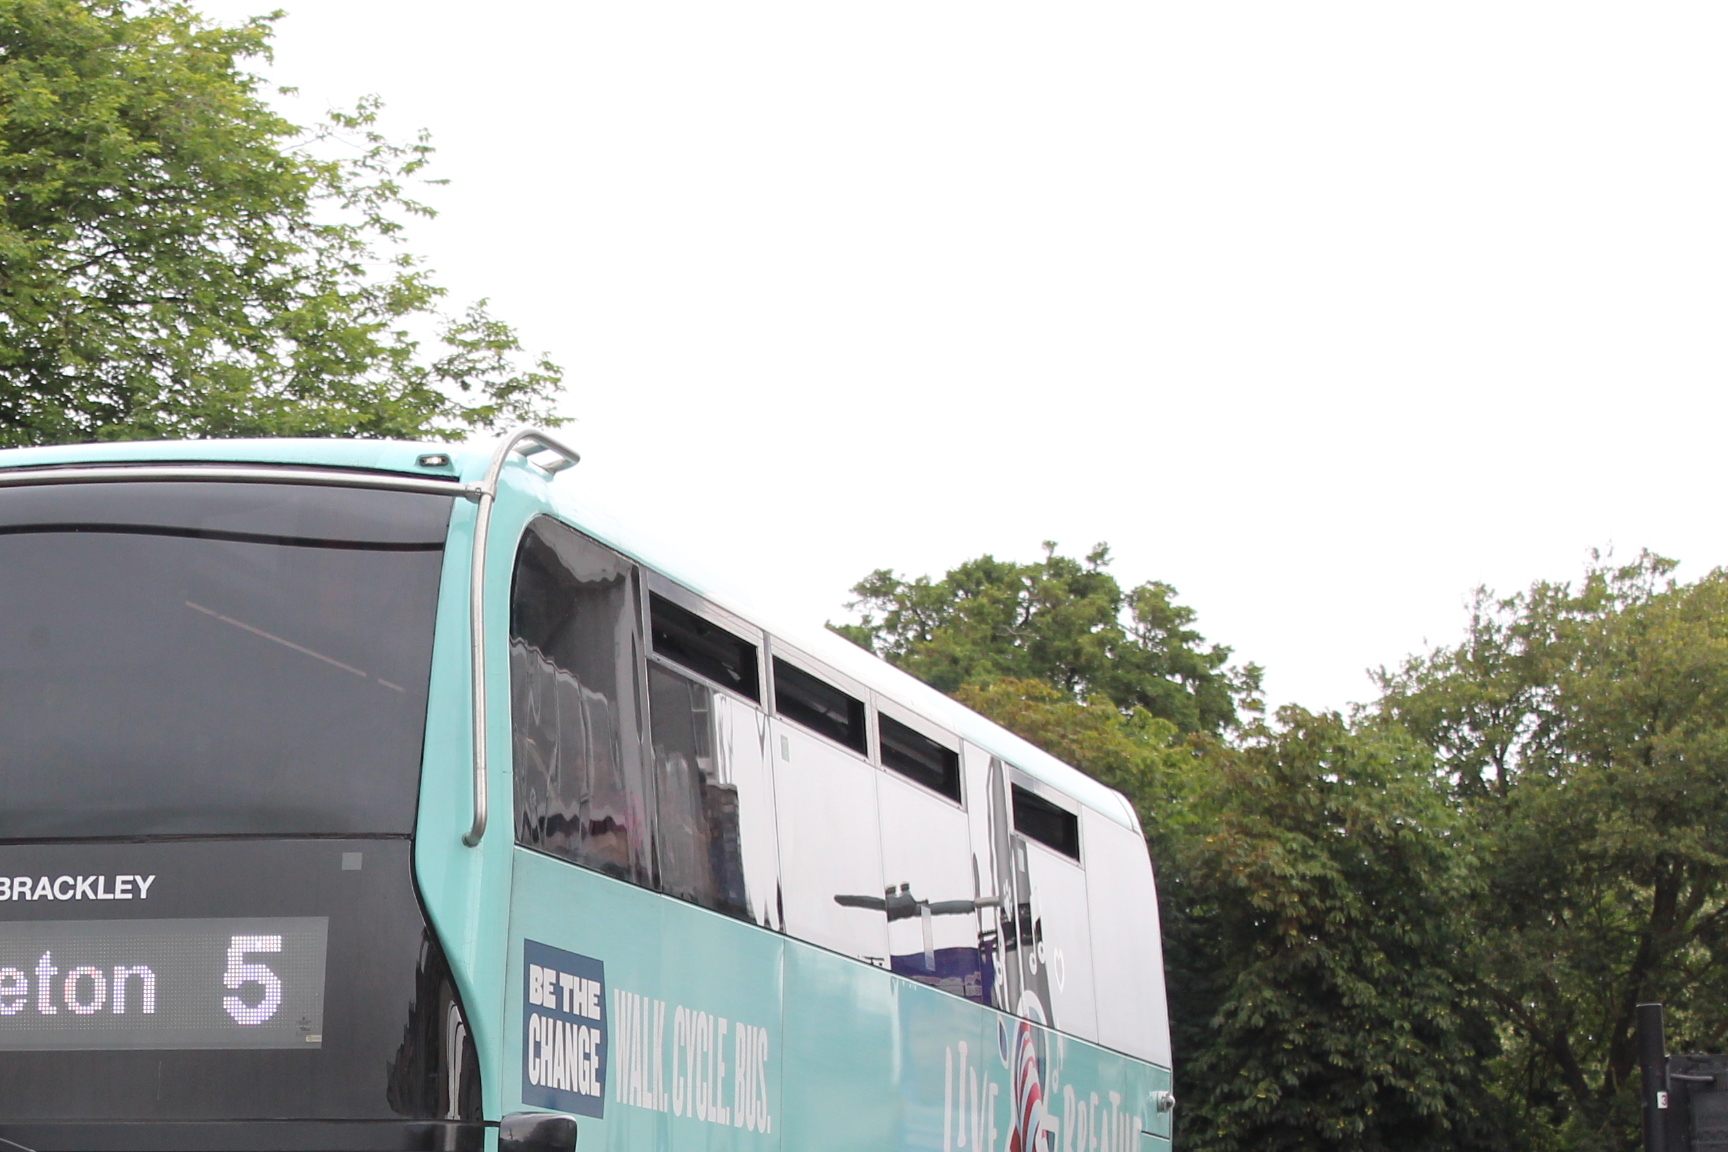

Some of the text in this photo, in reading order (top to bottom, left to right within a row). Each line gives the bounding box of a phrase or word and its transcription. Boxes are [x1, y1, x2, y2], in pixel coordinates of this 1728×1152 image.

[222, 934, 283, 1026] 5
[529, 963, 601, 1020] BE THE
[528, 1012, 601, 1098] CHANGE
[613, 988, 772, 1134] WALK. CYCLE. BUS.
